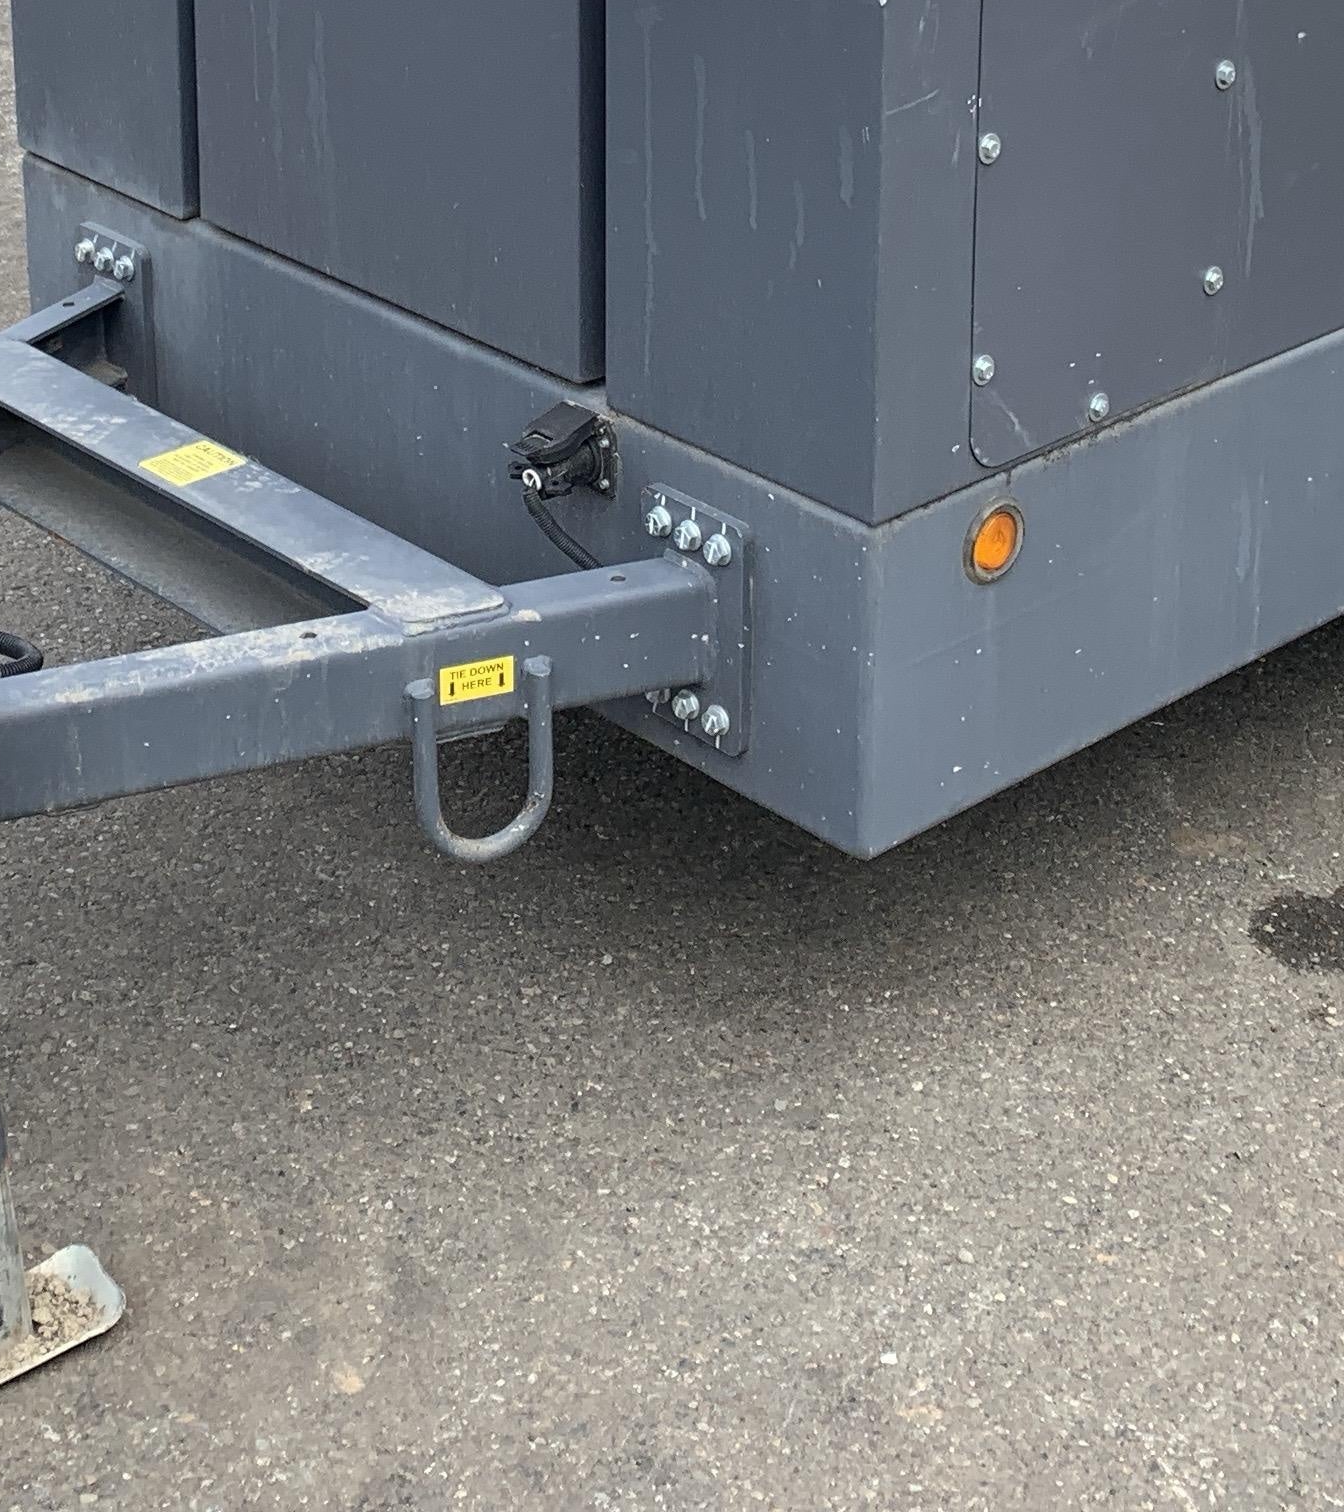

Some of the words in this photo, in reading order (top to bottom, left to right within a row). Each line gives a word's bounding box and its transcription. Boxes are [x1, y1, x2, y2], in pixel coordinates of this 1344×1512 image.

[450, 669, 466, 680] TIE
[470, 662, 504, 676] DOWN
[462, 677, 492, 691] HERE
